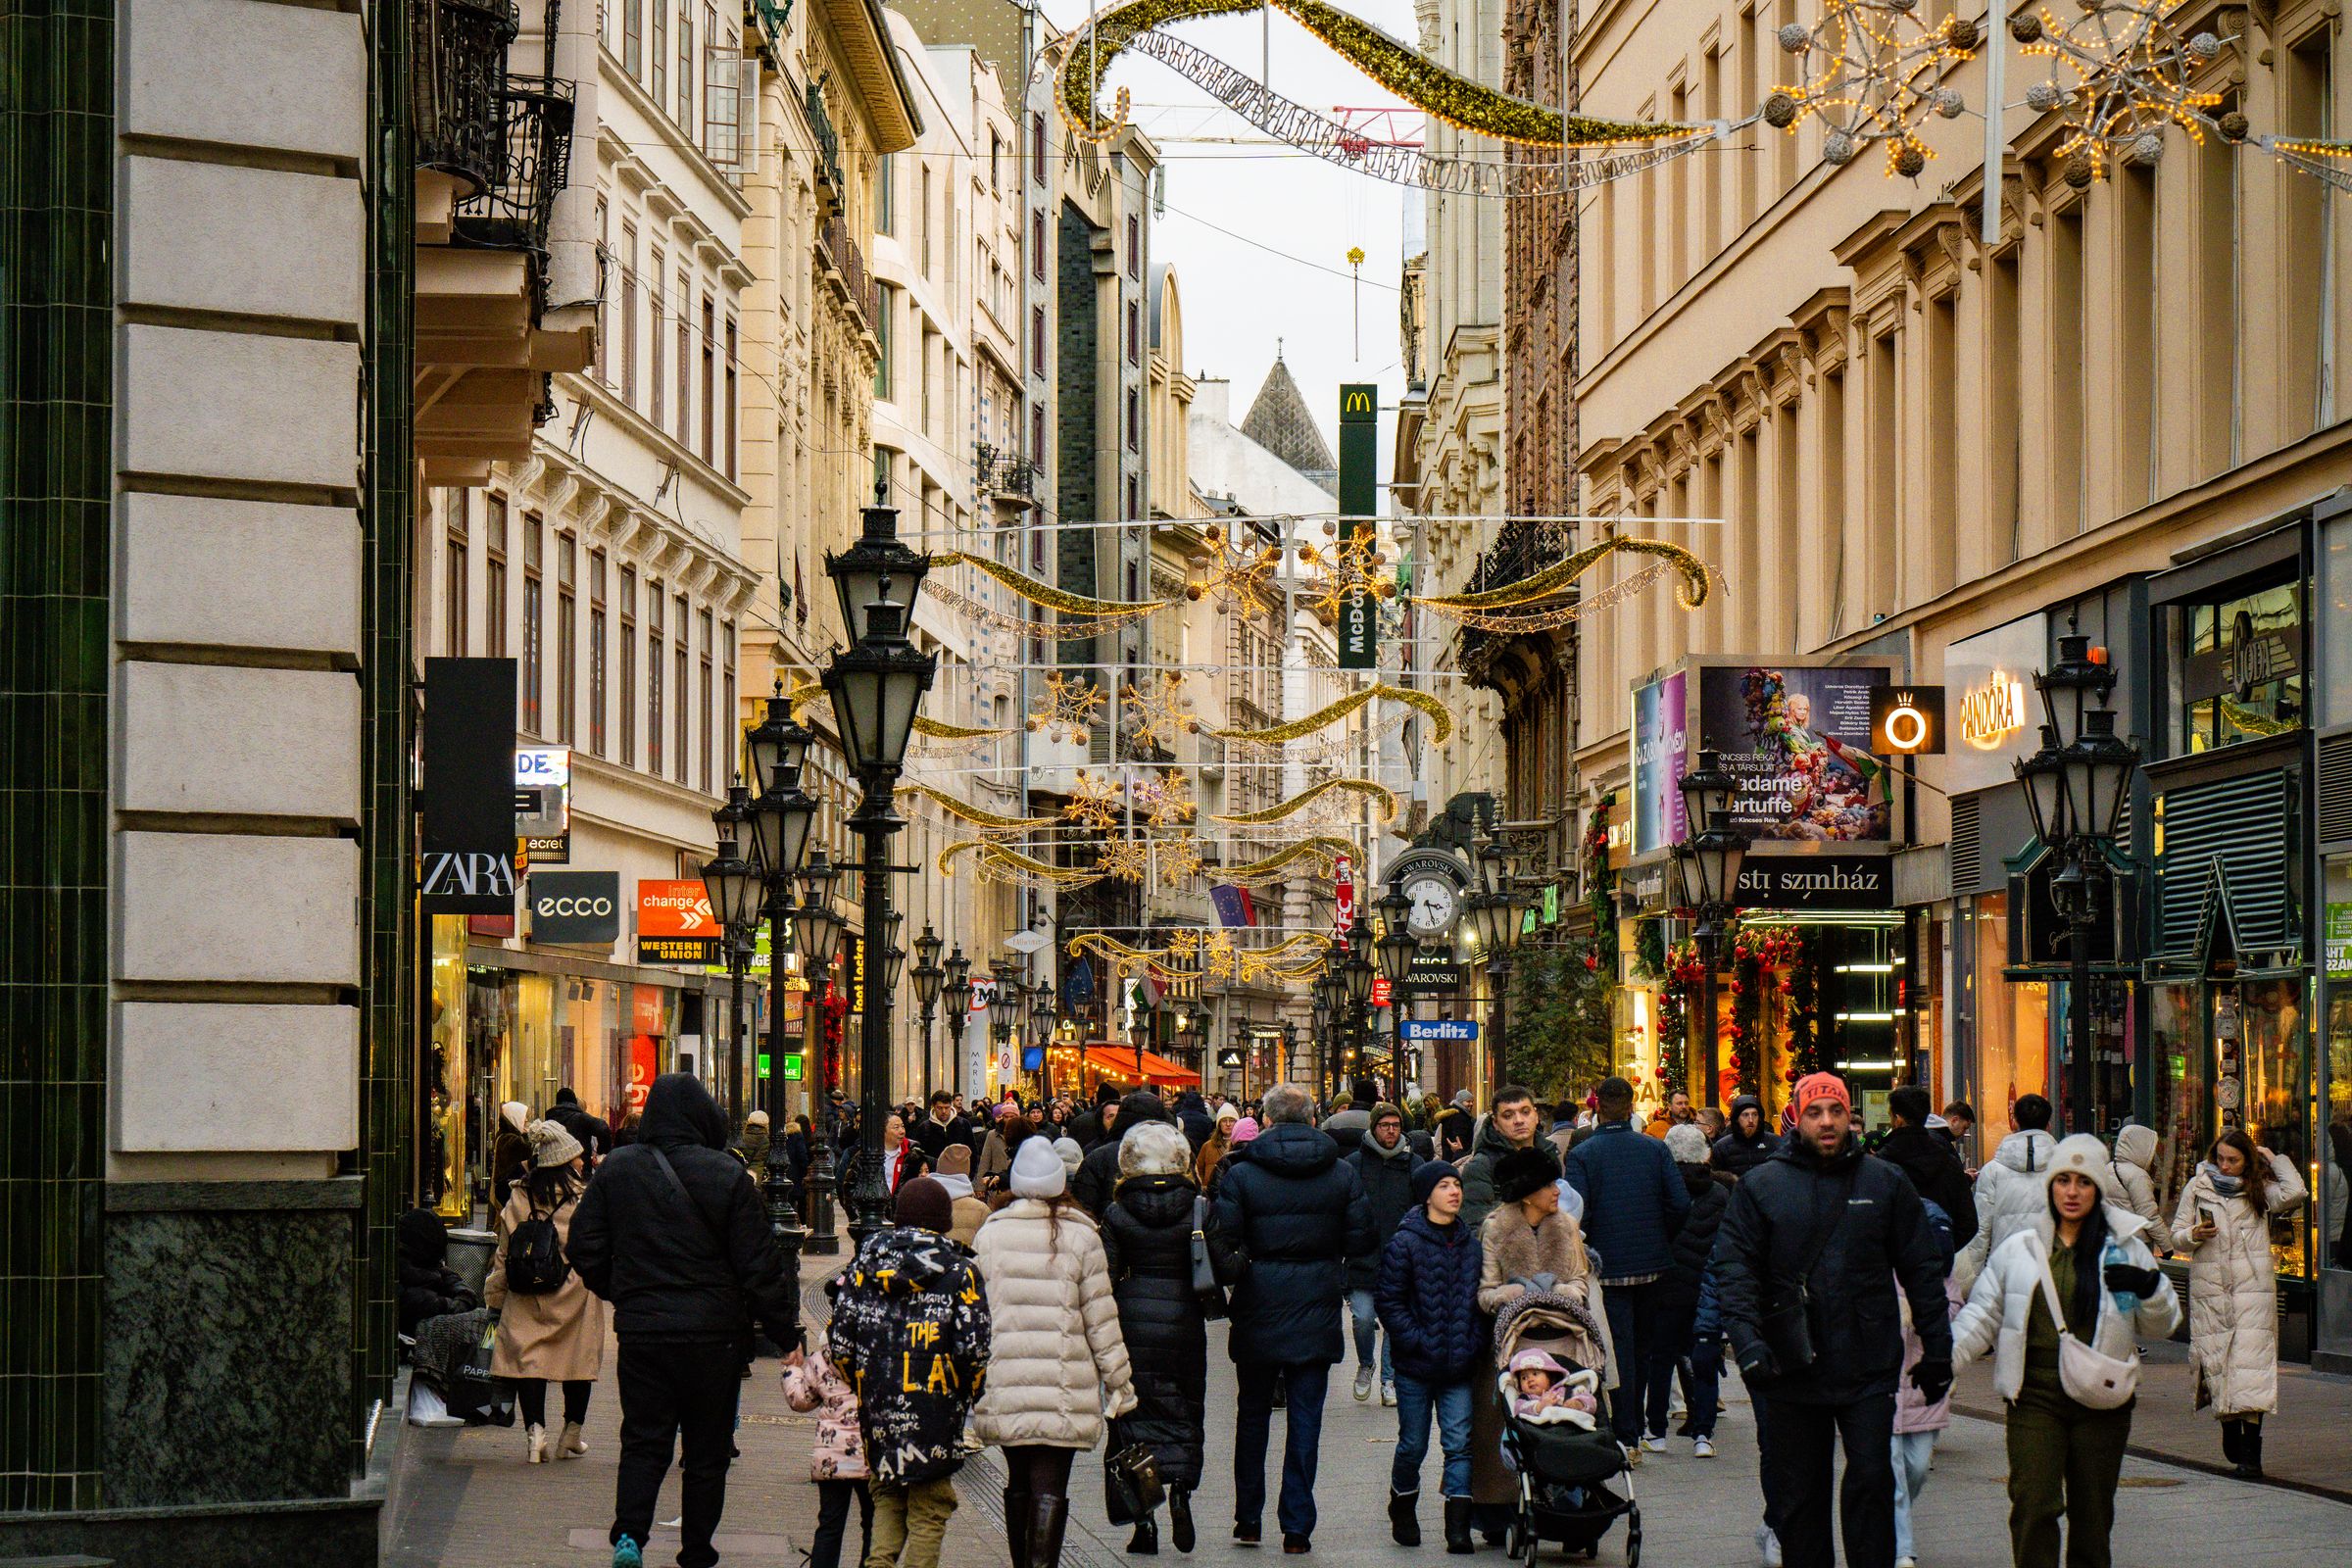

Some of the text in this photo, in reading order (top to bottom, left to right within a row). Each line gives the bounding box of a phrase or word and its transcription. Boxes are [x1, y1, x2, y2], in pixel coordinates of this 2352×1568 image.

[1960, 683, 2014, 740] PANDORA
[1730, 774, 1803, 792] adame
[1732, 797, 1793, 814] artuffe
[527, 838, 564, 849] ecret
[422, 852, 514, 897] ZARA
[1401, 859, 1454, 876] SWAROVSKI
[668, 884, 701, 898] inter
[537, 897, 612, 917] ecco
[643, 894, 695, 910] change
[641, 941, 703, 951] WESTERN
[661, 950, 703, 959] UNION
[853, 938, 864, 1012] Foot Locker
[1401, 973, 1457, 983] WAROVSKI
[1409, 1022, 1469, 1039] Berlitz
[906, 1320, 942, 1349] THE
